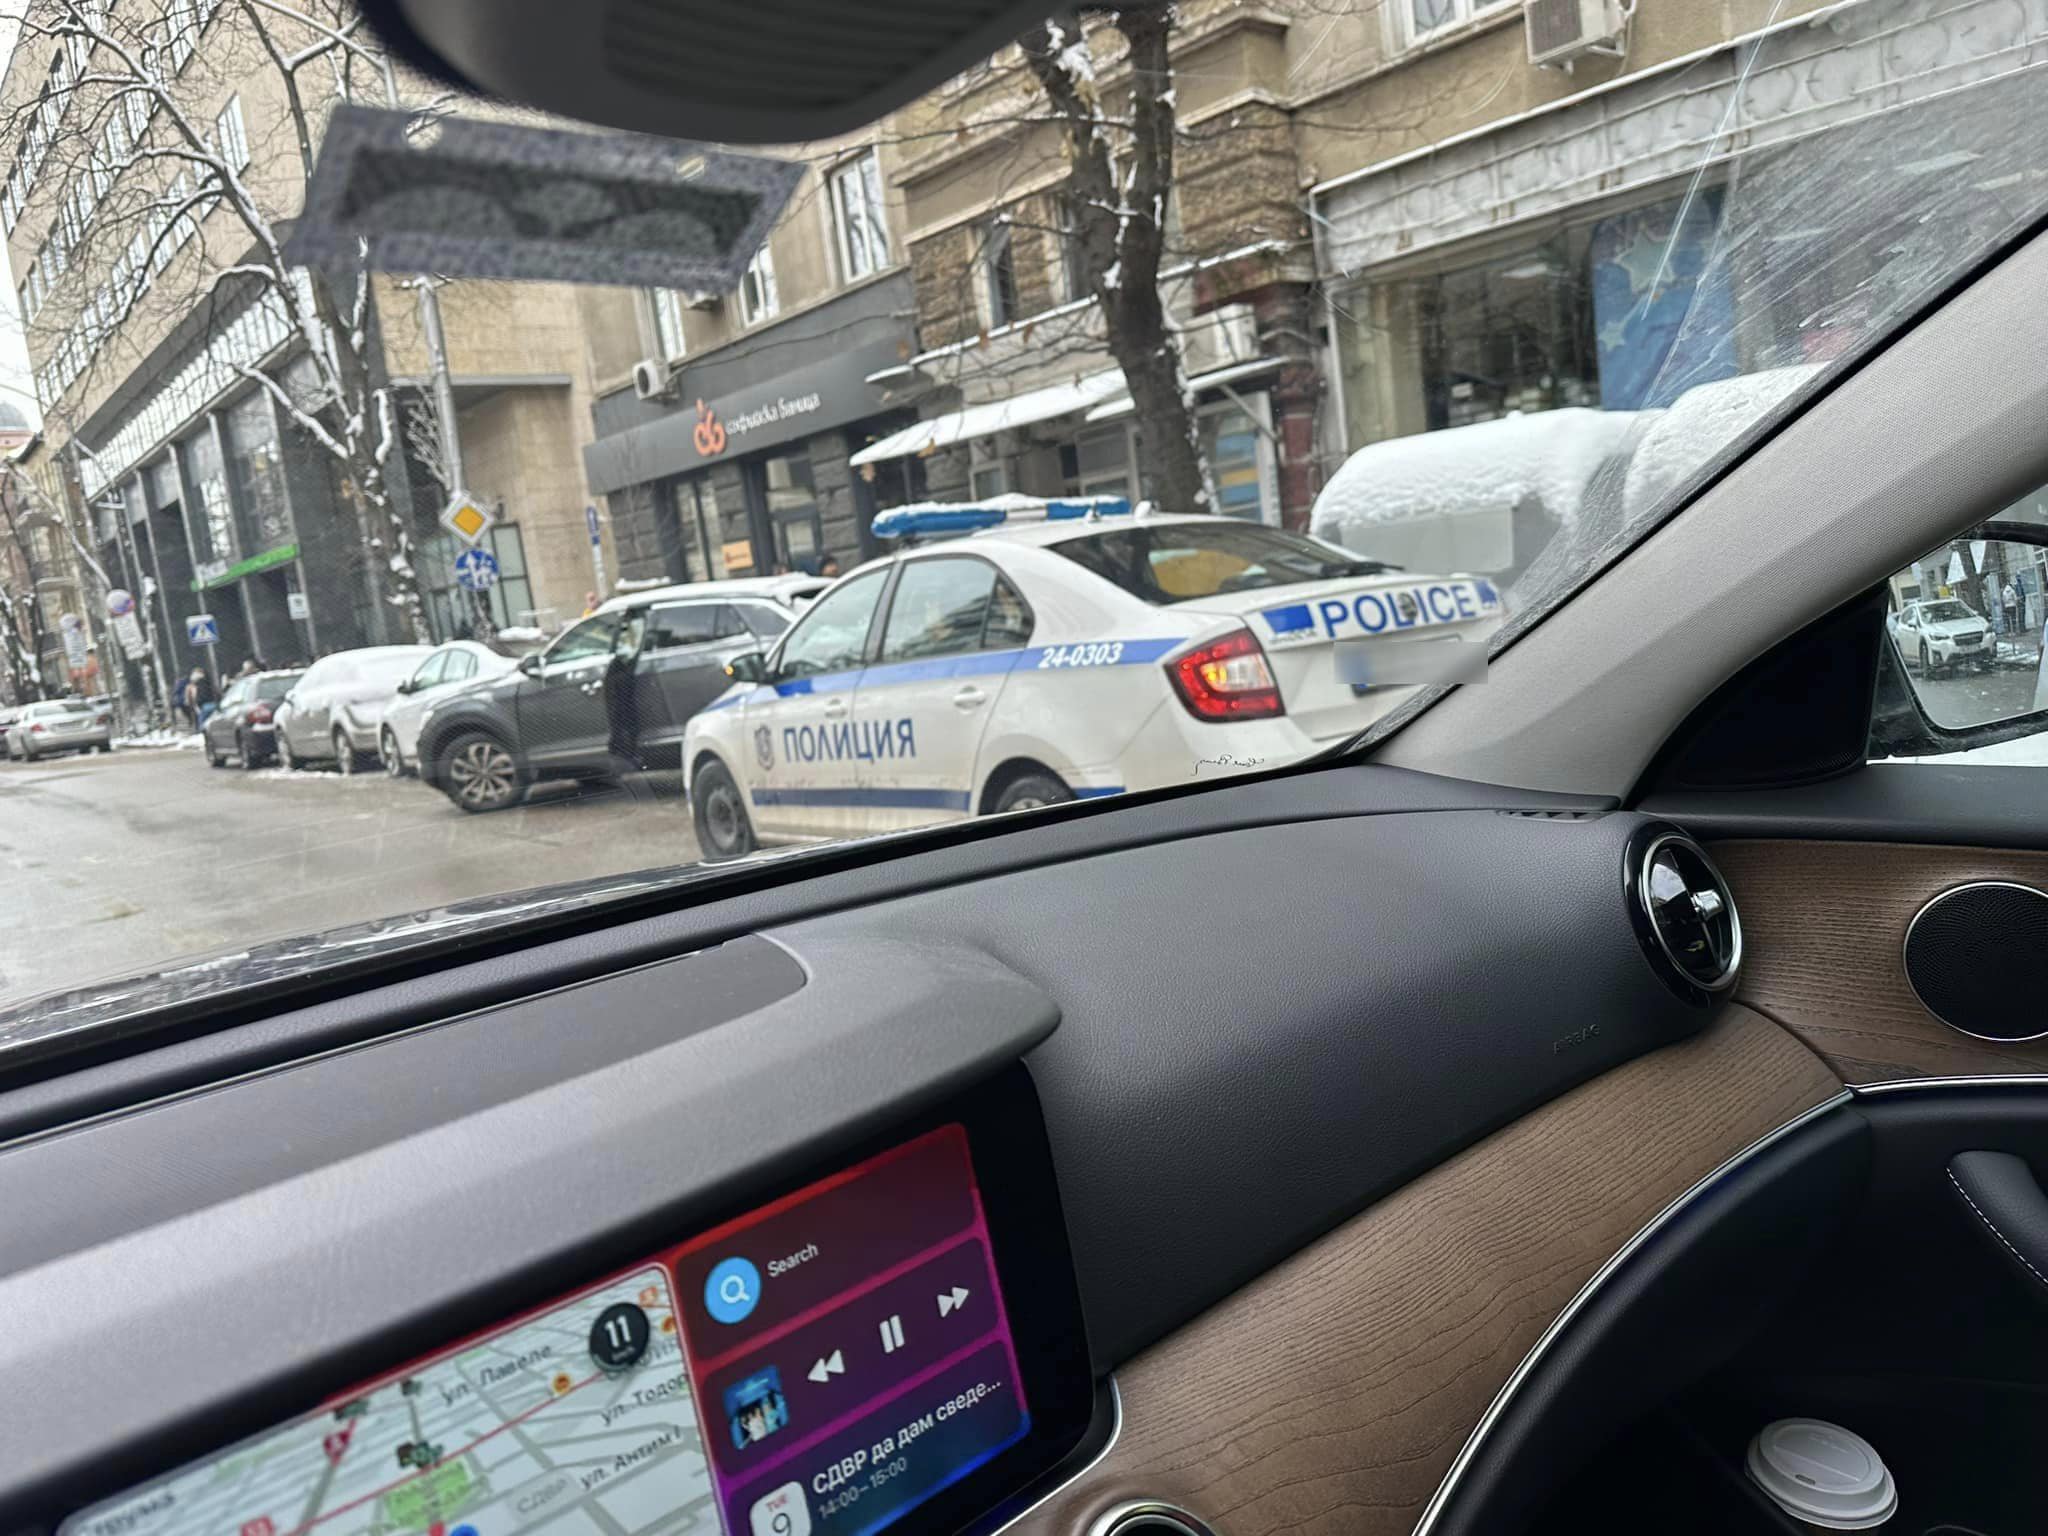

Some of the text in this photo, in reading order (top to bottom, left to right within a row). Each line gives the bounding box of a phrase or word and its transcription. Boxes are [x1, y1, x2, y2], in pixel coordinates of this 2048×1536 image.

[1318, 584, 1477, 639] POLICE
[1038, 641, 1124, 669] 24-0303
[783, 718, 917, 765] ПОЛИЦИЯ
[767, 1242, 819, 1278] Search
[605, 1315, 632, 1348] 11
[613, 1434, 672, 1474] Антим
[812, 1449, 868, 1495] СДВР
[871, 1438, 896, 1464] да
[898, 1413, 935, 1449] дам
[771, 1512, 793, 1536] 9
